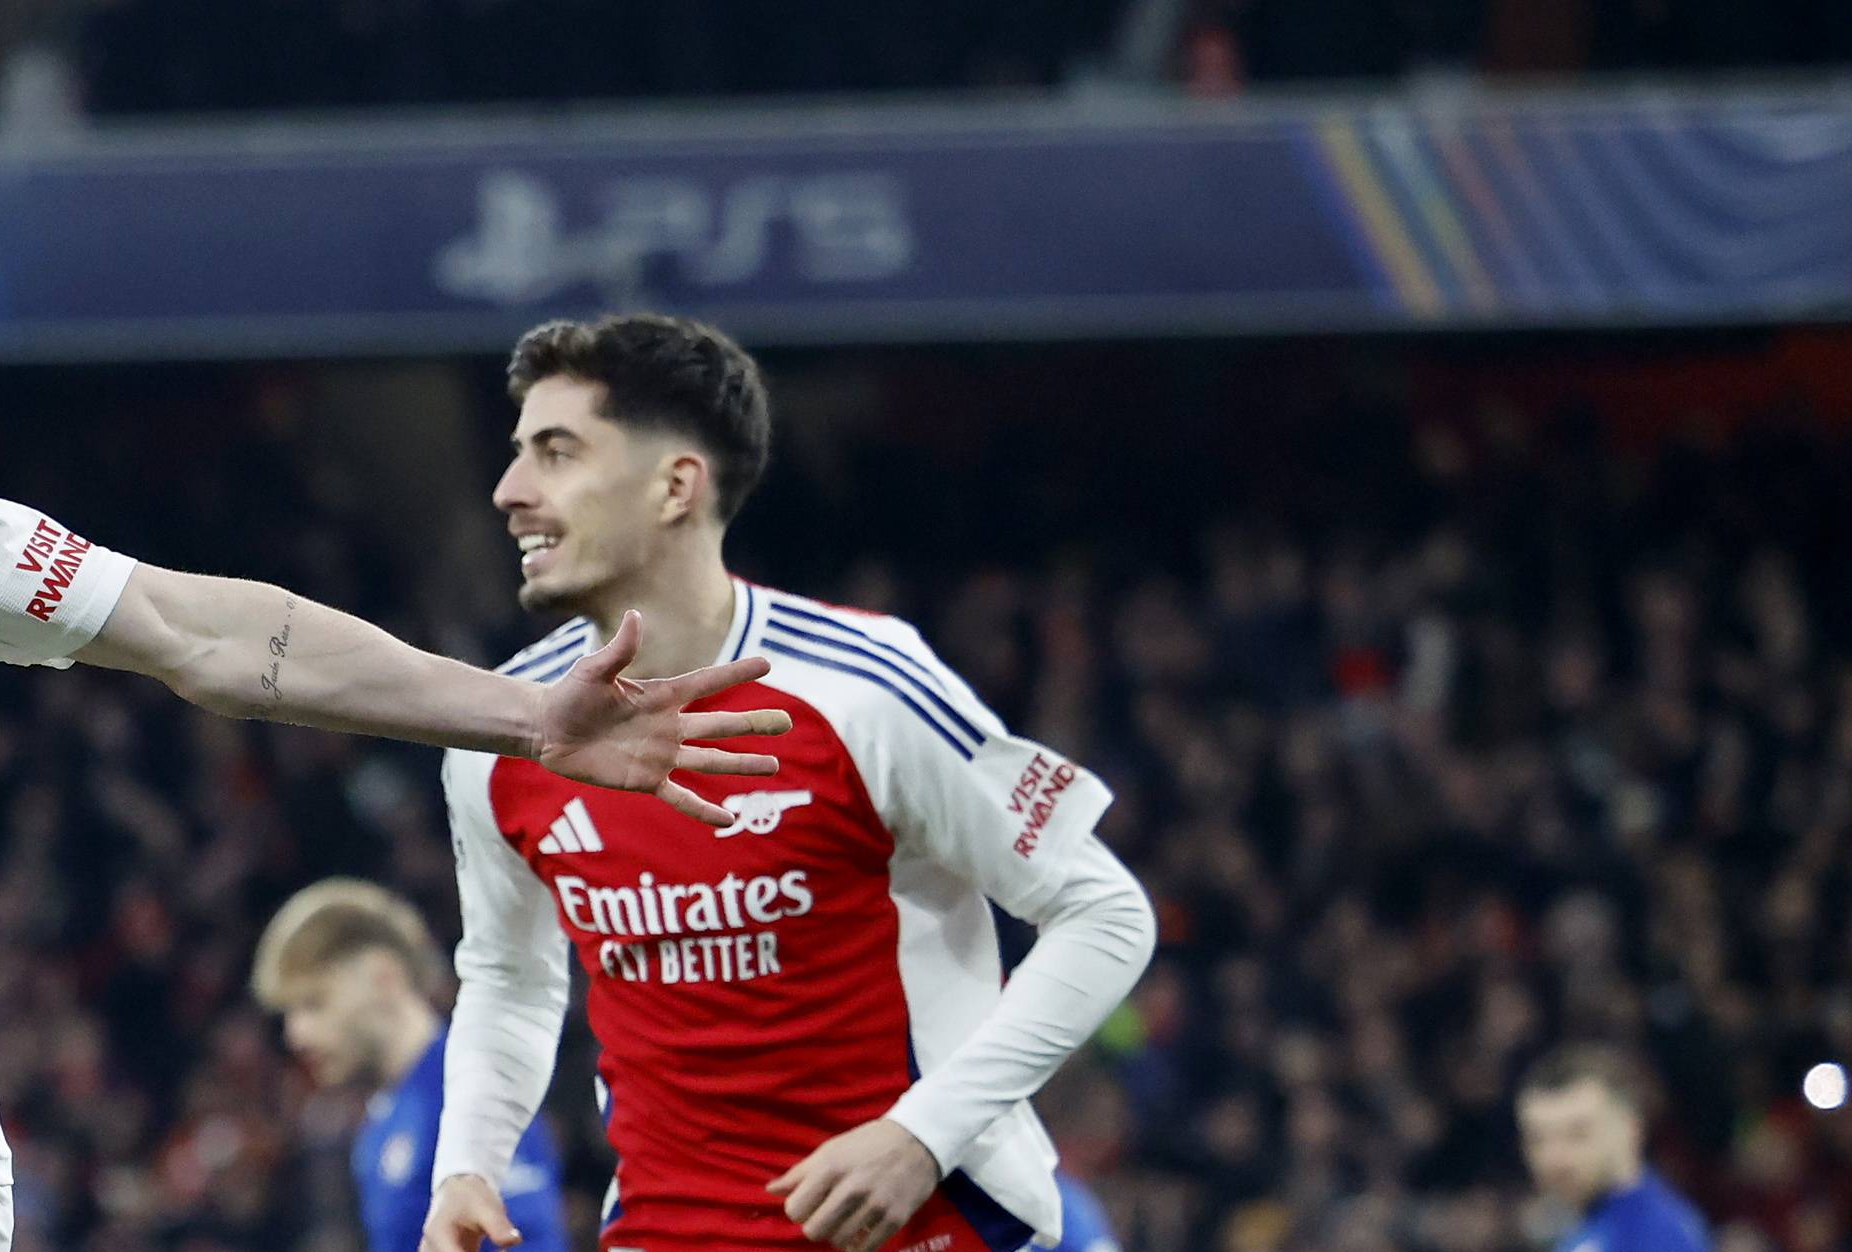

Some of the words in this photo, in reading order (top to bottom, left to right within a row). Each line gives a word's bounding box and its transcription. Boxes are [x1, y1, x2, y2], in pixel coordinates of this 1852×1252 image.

[15, 518, 61, 573] VISIT
[25, 532, 91, 622] RWAN
[1008, 752, 1050, 813] VISIT
[554, 870, 813, 936] Emirates
[659, 931, 782, 984] BETTER
